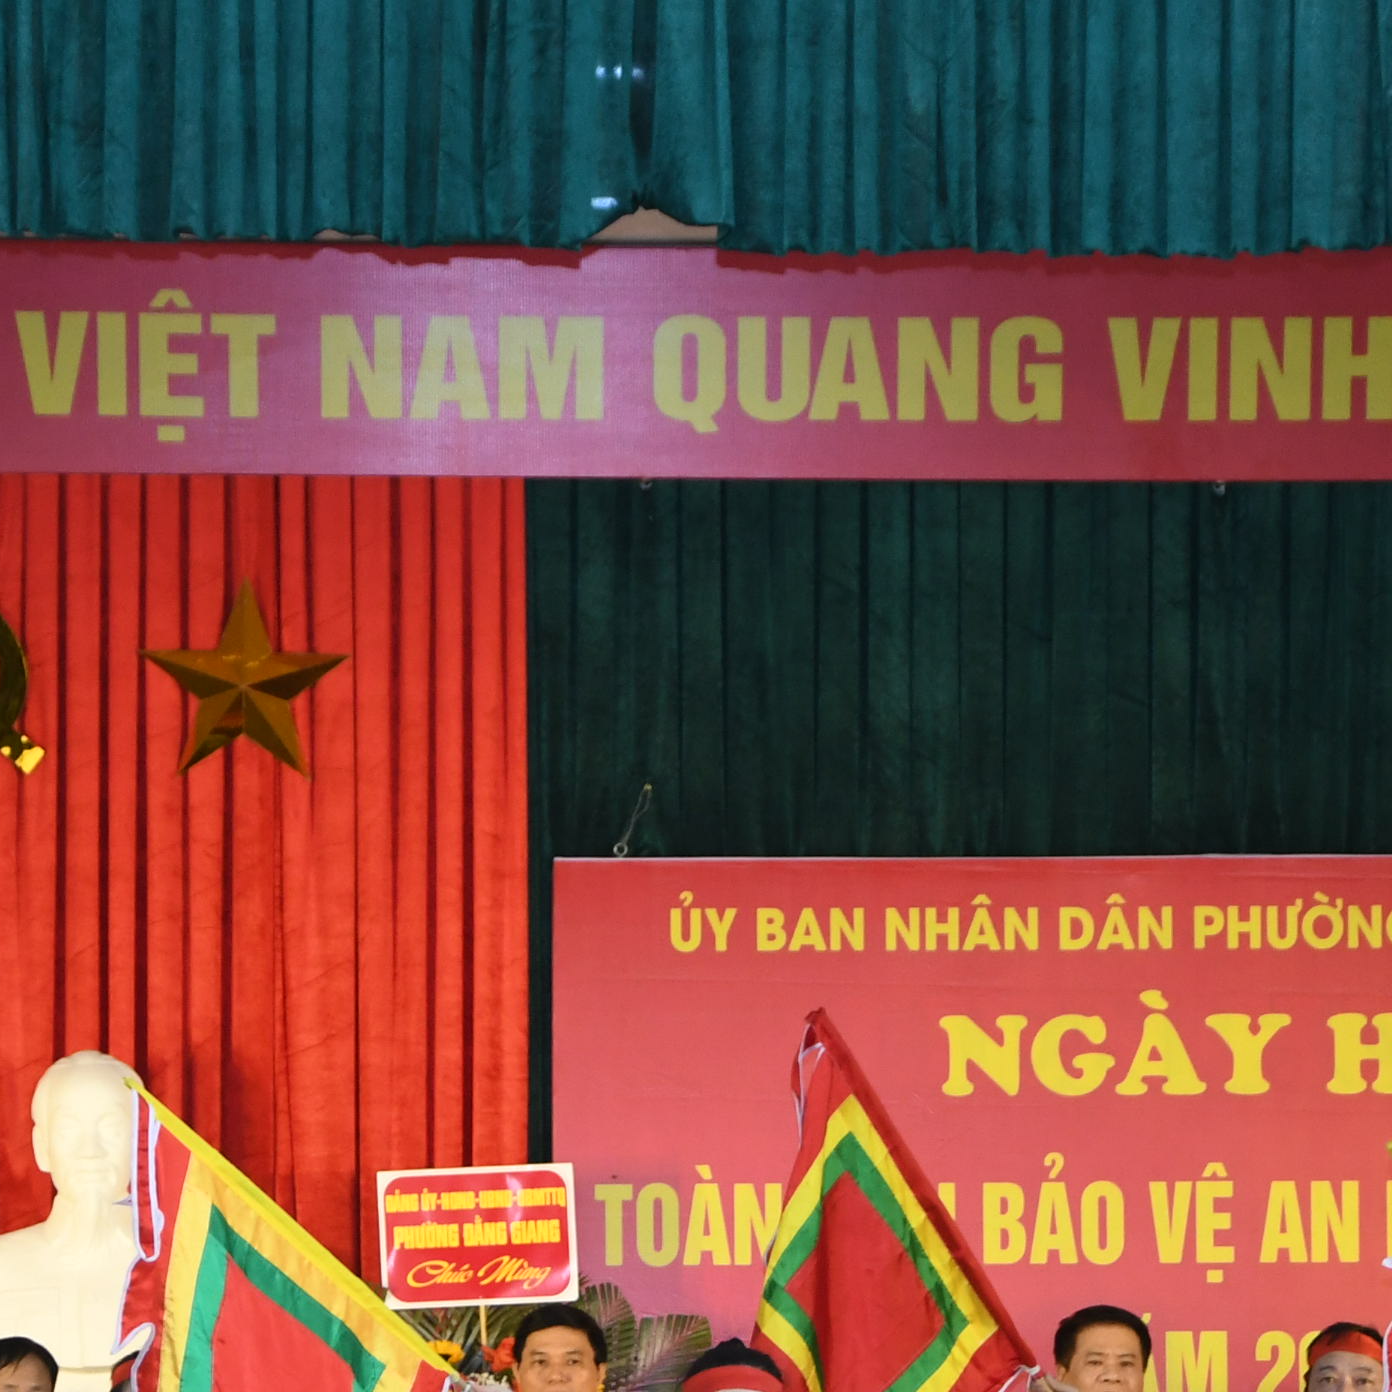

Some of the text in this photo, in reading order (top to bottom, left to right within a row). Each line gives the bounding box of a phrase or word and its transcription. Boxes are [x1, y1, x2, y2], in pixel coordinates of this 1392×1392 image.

[17, 291, 274, 441] VIỆT
[324, 317, 599, 417] NAM
[656, 317, 1063, 432] QUANG
[669, 891, 738, 953] ỦY
[756, 907, 866, 952] BAN
[885, 893, 1040, 952] NHÂN
[1059, 893, 1175, 951] DÂN
[939, 989, 1293, 1096] NGÀY
[510, 1218, 560, 1245] GIANG
[594, 1165, 782, 1267] TOÀN
[982, 1152, 1126, 1265] BẢO
[1149, 1162, 1236, 1283] VỆ
[1259, 1180, 1361, 1264] AN
